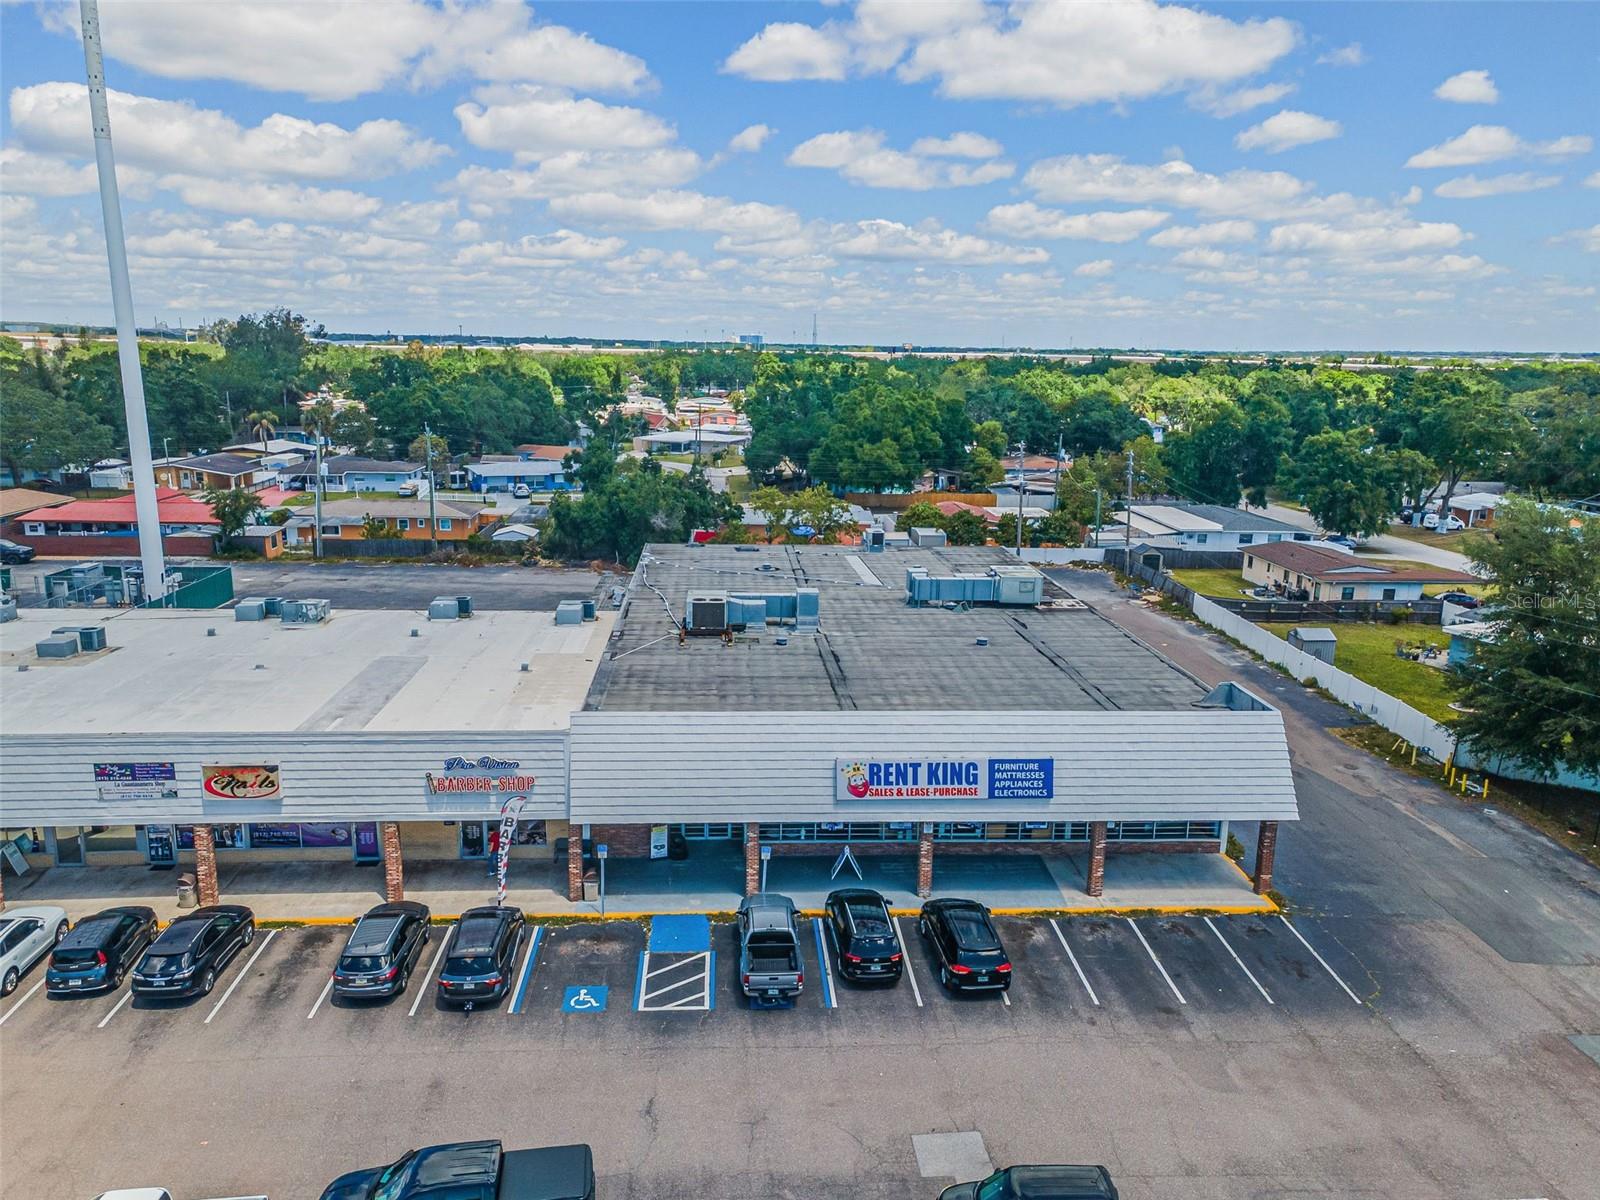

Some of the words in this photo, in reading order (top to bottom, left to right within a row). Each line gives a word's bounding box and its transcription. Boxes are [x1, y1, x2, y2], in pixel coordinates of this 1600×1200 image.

[477, 756, 520, 770] Vision
[995, 763, 1039, 771] FURNITURE
[868, 762, 921, 786] RENT
[927, 762, 978, 786] KING
[995, 772, 1045, 780] MATTRESSES
[437, 777, 492, 792] BARBER
[499, 776, 535, 791] SHOP
[995, 781, 1043, 789] APPLIANCES
[868, 788, 894, 797] SALES
[896, 788, 903, 797] &
[906, 788, 978, 797] LEASE-PURCHASE
[995, 789, 1048, 797] ELECTRONICS
